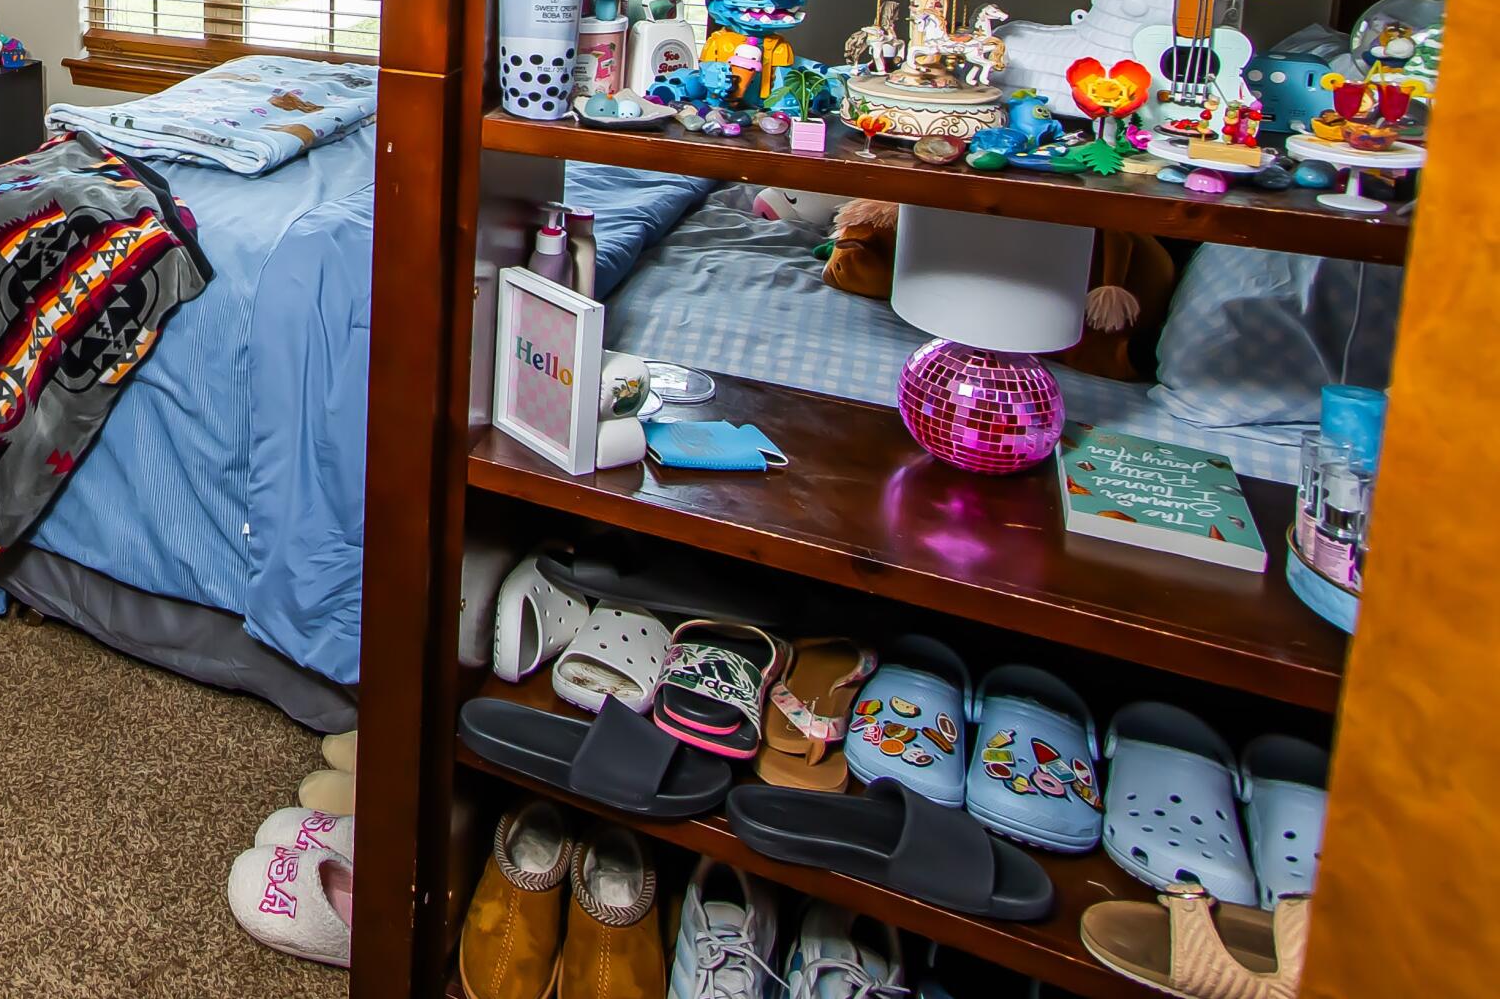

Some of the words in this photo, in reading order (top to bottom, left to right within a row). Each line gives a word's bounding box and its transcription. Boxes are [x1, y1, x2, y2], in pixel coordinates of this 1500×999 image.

[534, 4, 559, 12] SWEET
[663, 50, 680, 61] Ice
[516, 335, 573, 386] Hello
[1087, 445, 1140, 462] Han
[1142, 451, 1208, 474] Jenny
[1109, 460, 1199, 488] Pretty
[1092, 475, 1197, 501] Turned
[1190, 490, 1220, 503] I
[1100, 489, 1222, 517] Summer
[1142, 509, 1204, 528] The
[670, 669, 747, 700] adidas
